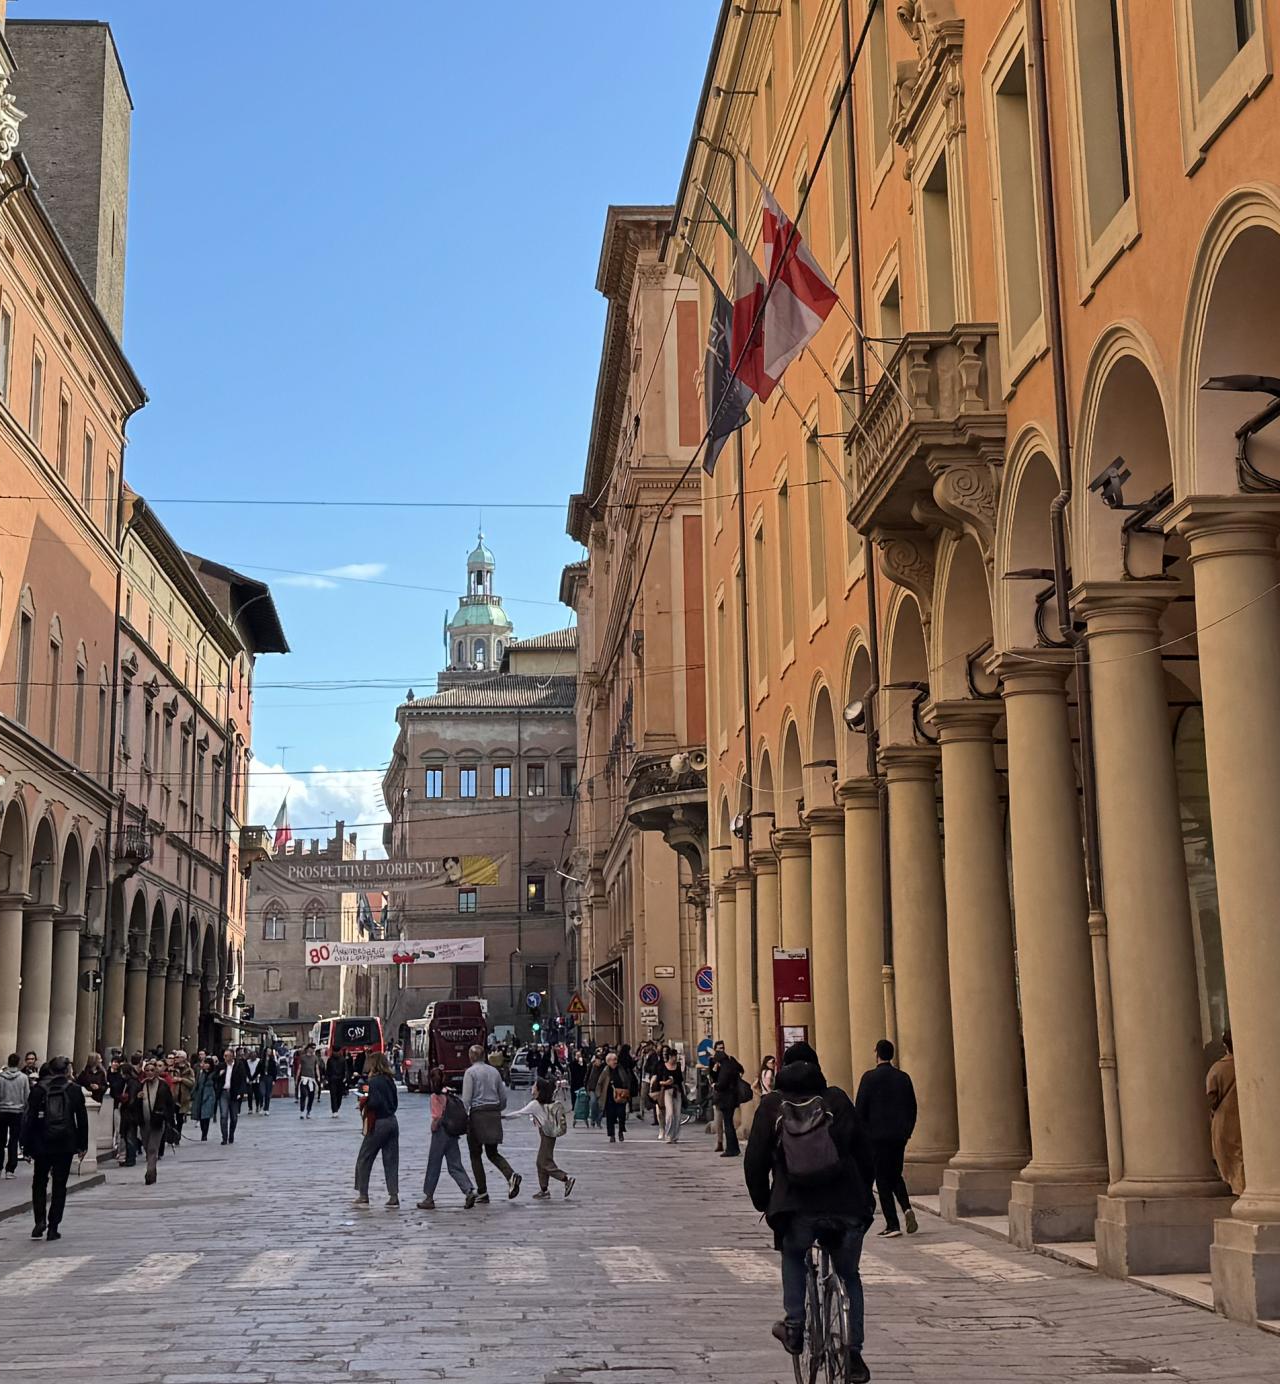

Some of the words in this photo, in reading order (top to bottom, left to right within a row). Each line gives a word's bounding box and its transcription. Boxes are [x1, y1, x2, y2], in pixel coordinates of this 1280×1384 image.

[288, 864, 371, 878] PROSPETTIVE
[376, 861, 440, 876] D'ORIENTE
[347, 1026, 365, 1038] City
